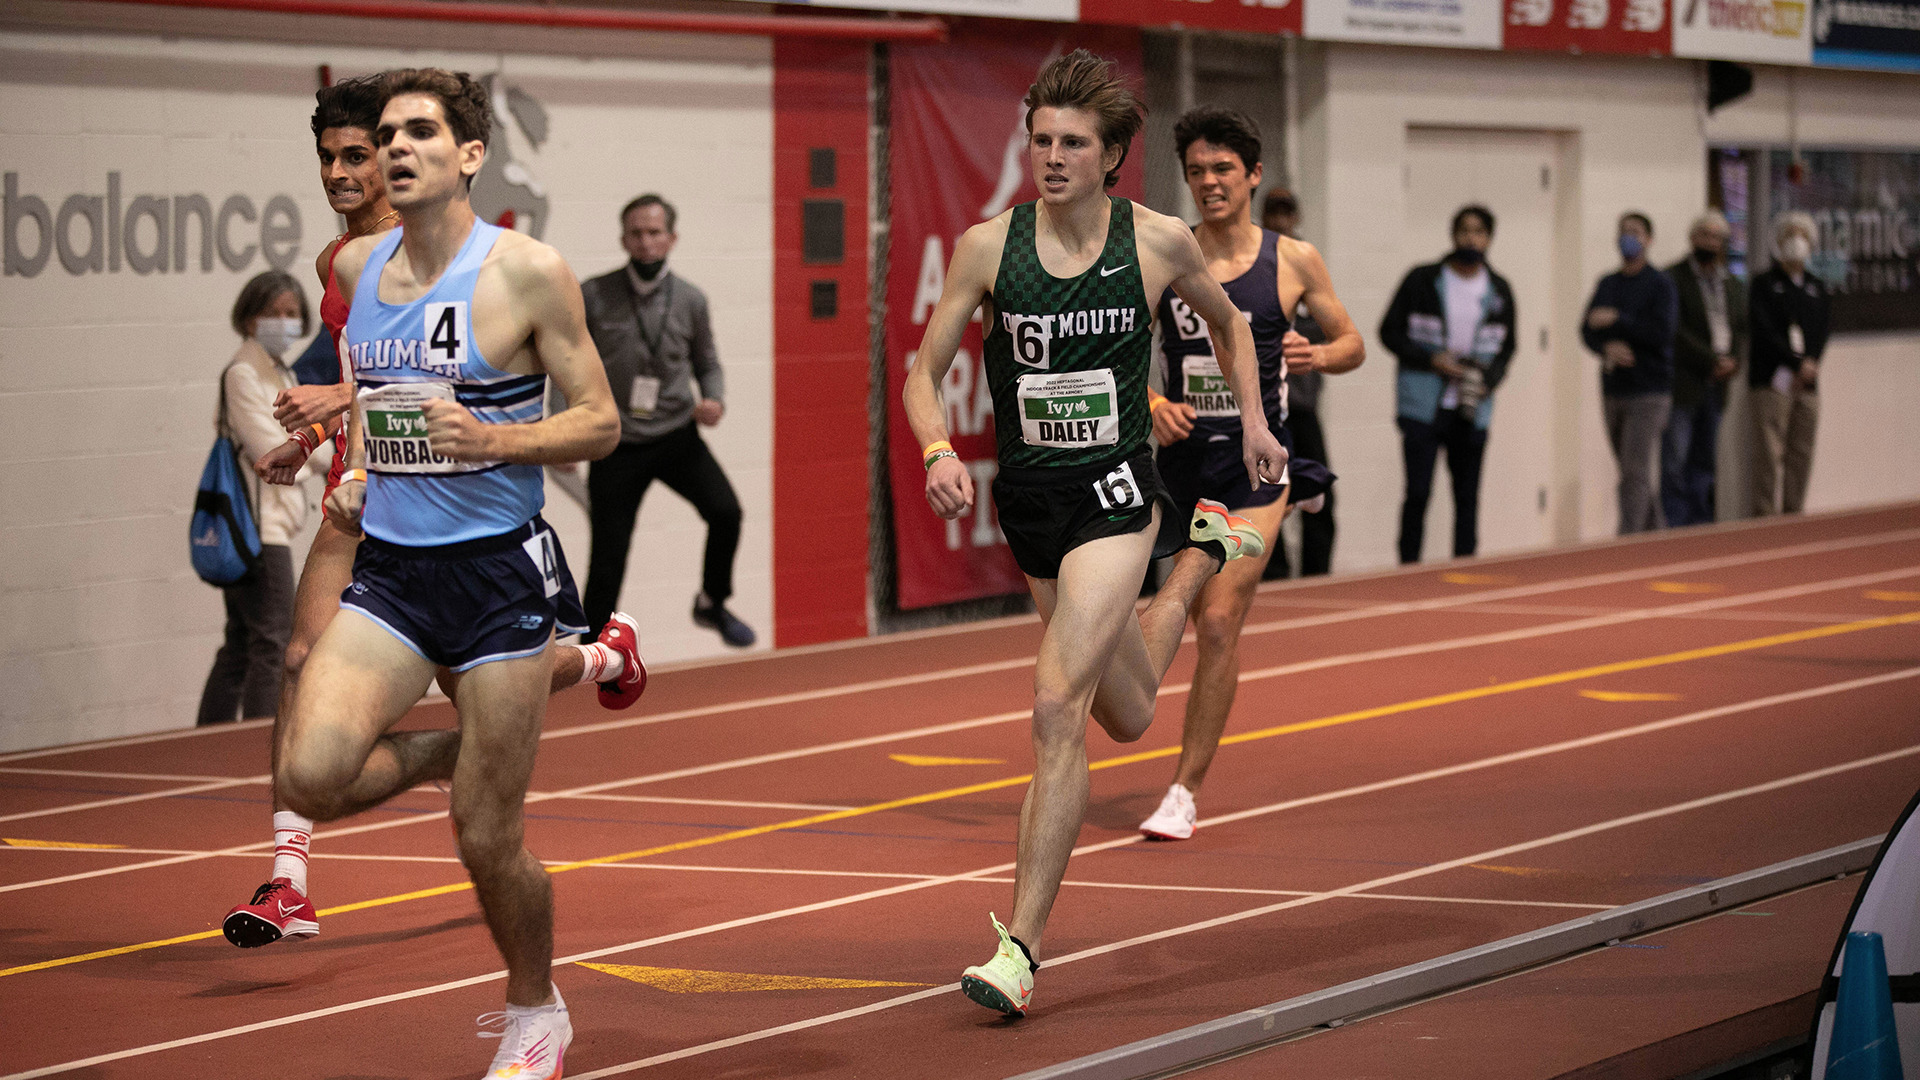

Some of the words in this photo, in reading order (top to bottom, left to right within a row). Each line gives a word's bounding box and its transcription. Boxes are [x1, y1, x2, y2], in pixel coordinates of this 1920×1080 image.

[3, 171, 302, 278] balance
[430, 306, 460, 360] 4
[1002, 308, 1135, 339] DTMOUTH
[1177, 302, 1199, 335] 3
[1017, 321, 1043, 364] 6
[1073, 381, 1106, 389] CHAMPIONSHIPS
[386, 413, 413, 436] Ivy
[1046, 400, 1074, 418] Ivy
[1038, 419, 1099, 442] DALEY
[367, 438, 457, 465] VORBA
[1098, 466, 1135, 508] 6
[540, 536, 559, 588] 4
